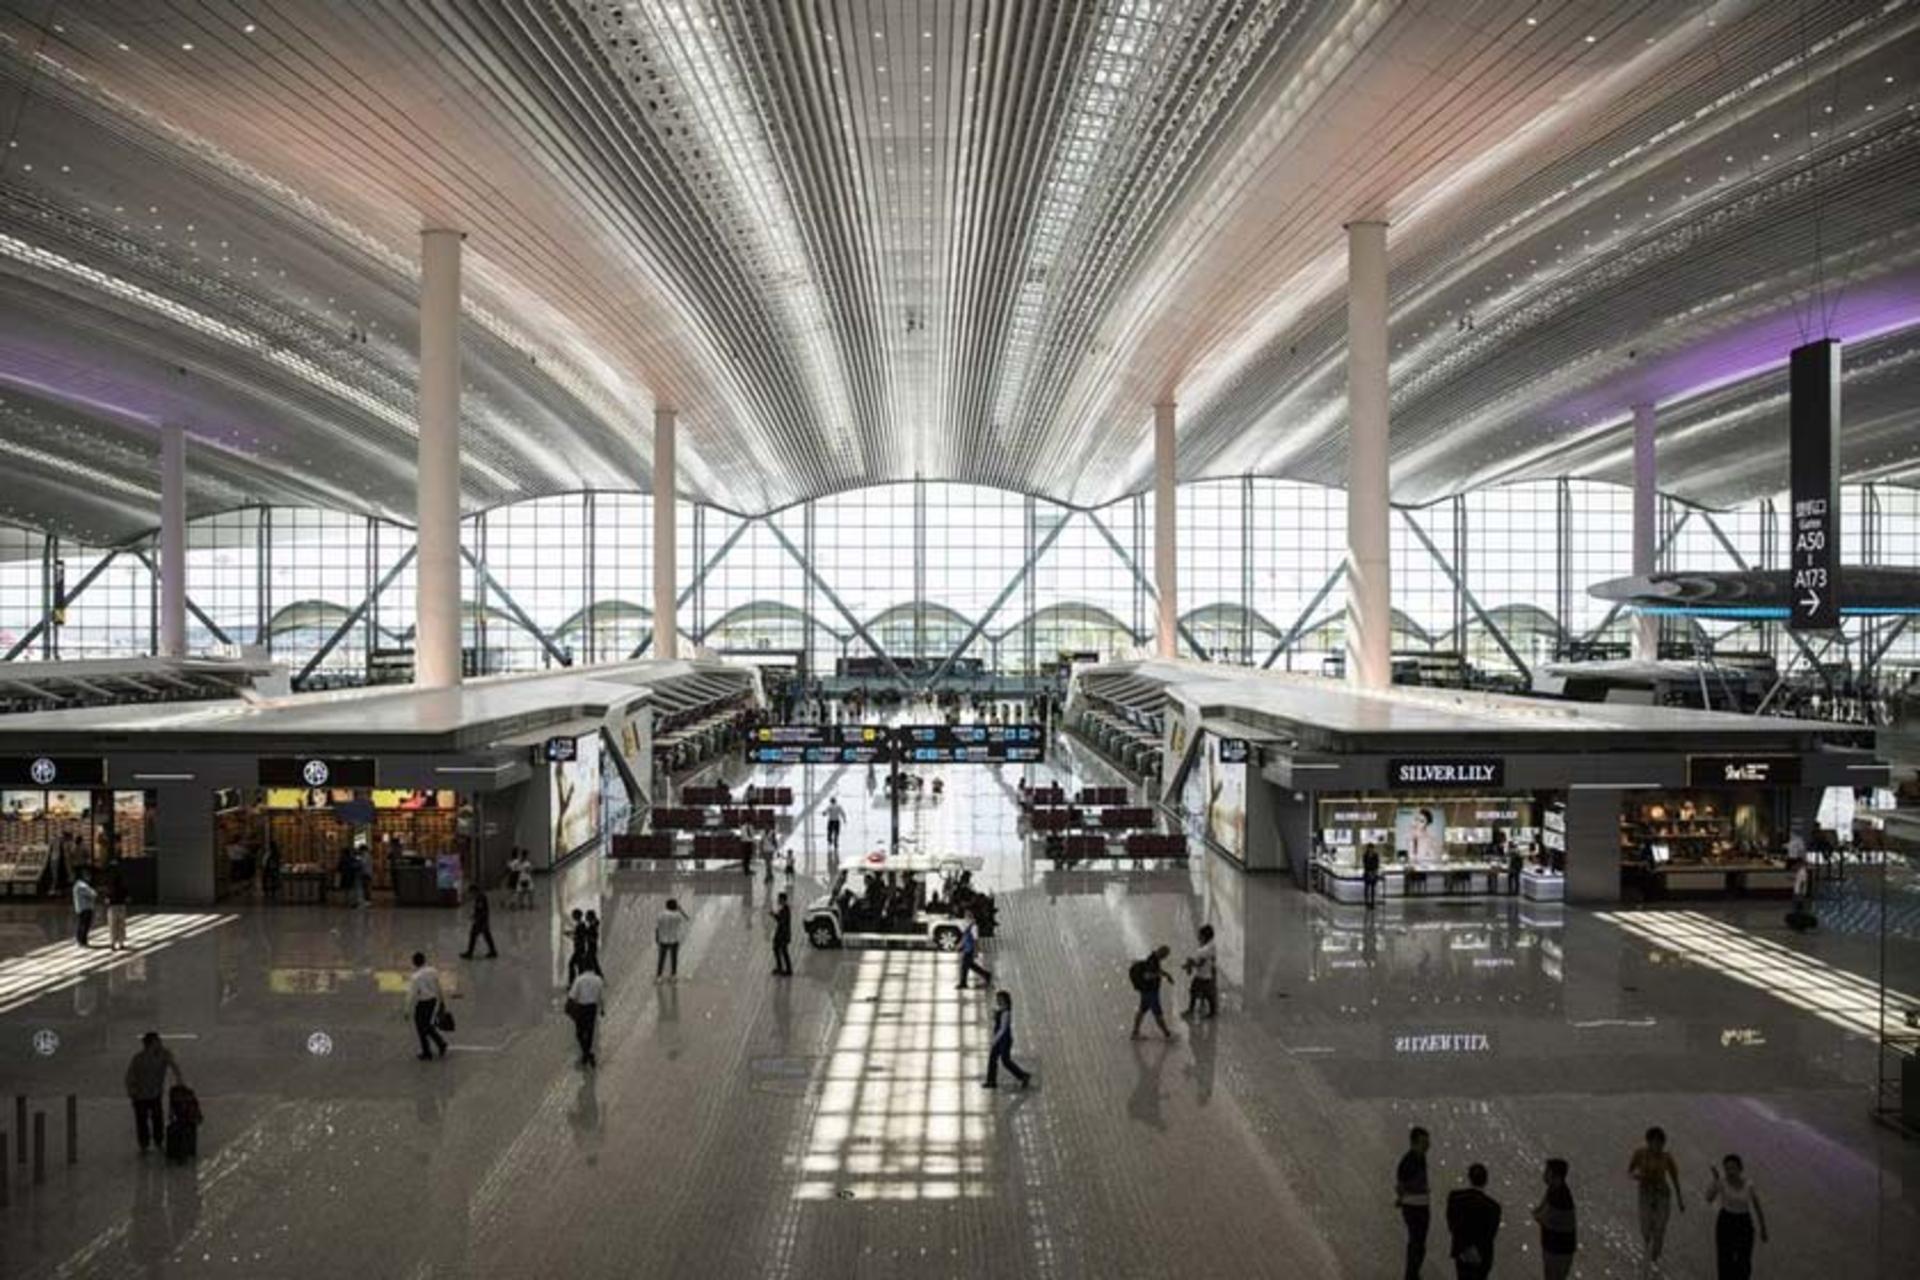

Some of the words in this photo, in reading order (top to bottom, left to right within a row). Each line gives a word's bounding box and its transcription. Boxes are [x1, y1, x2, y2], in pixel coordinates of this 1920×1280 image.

[1796, 530, 1825, 552] A50
[1794, 567, 1827, 589] A173
[1400, 765, 1456, 781] SILVER
[1458, 765, 1496, 781] LILY
